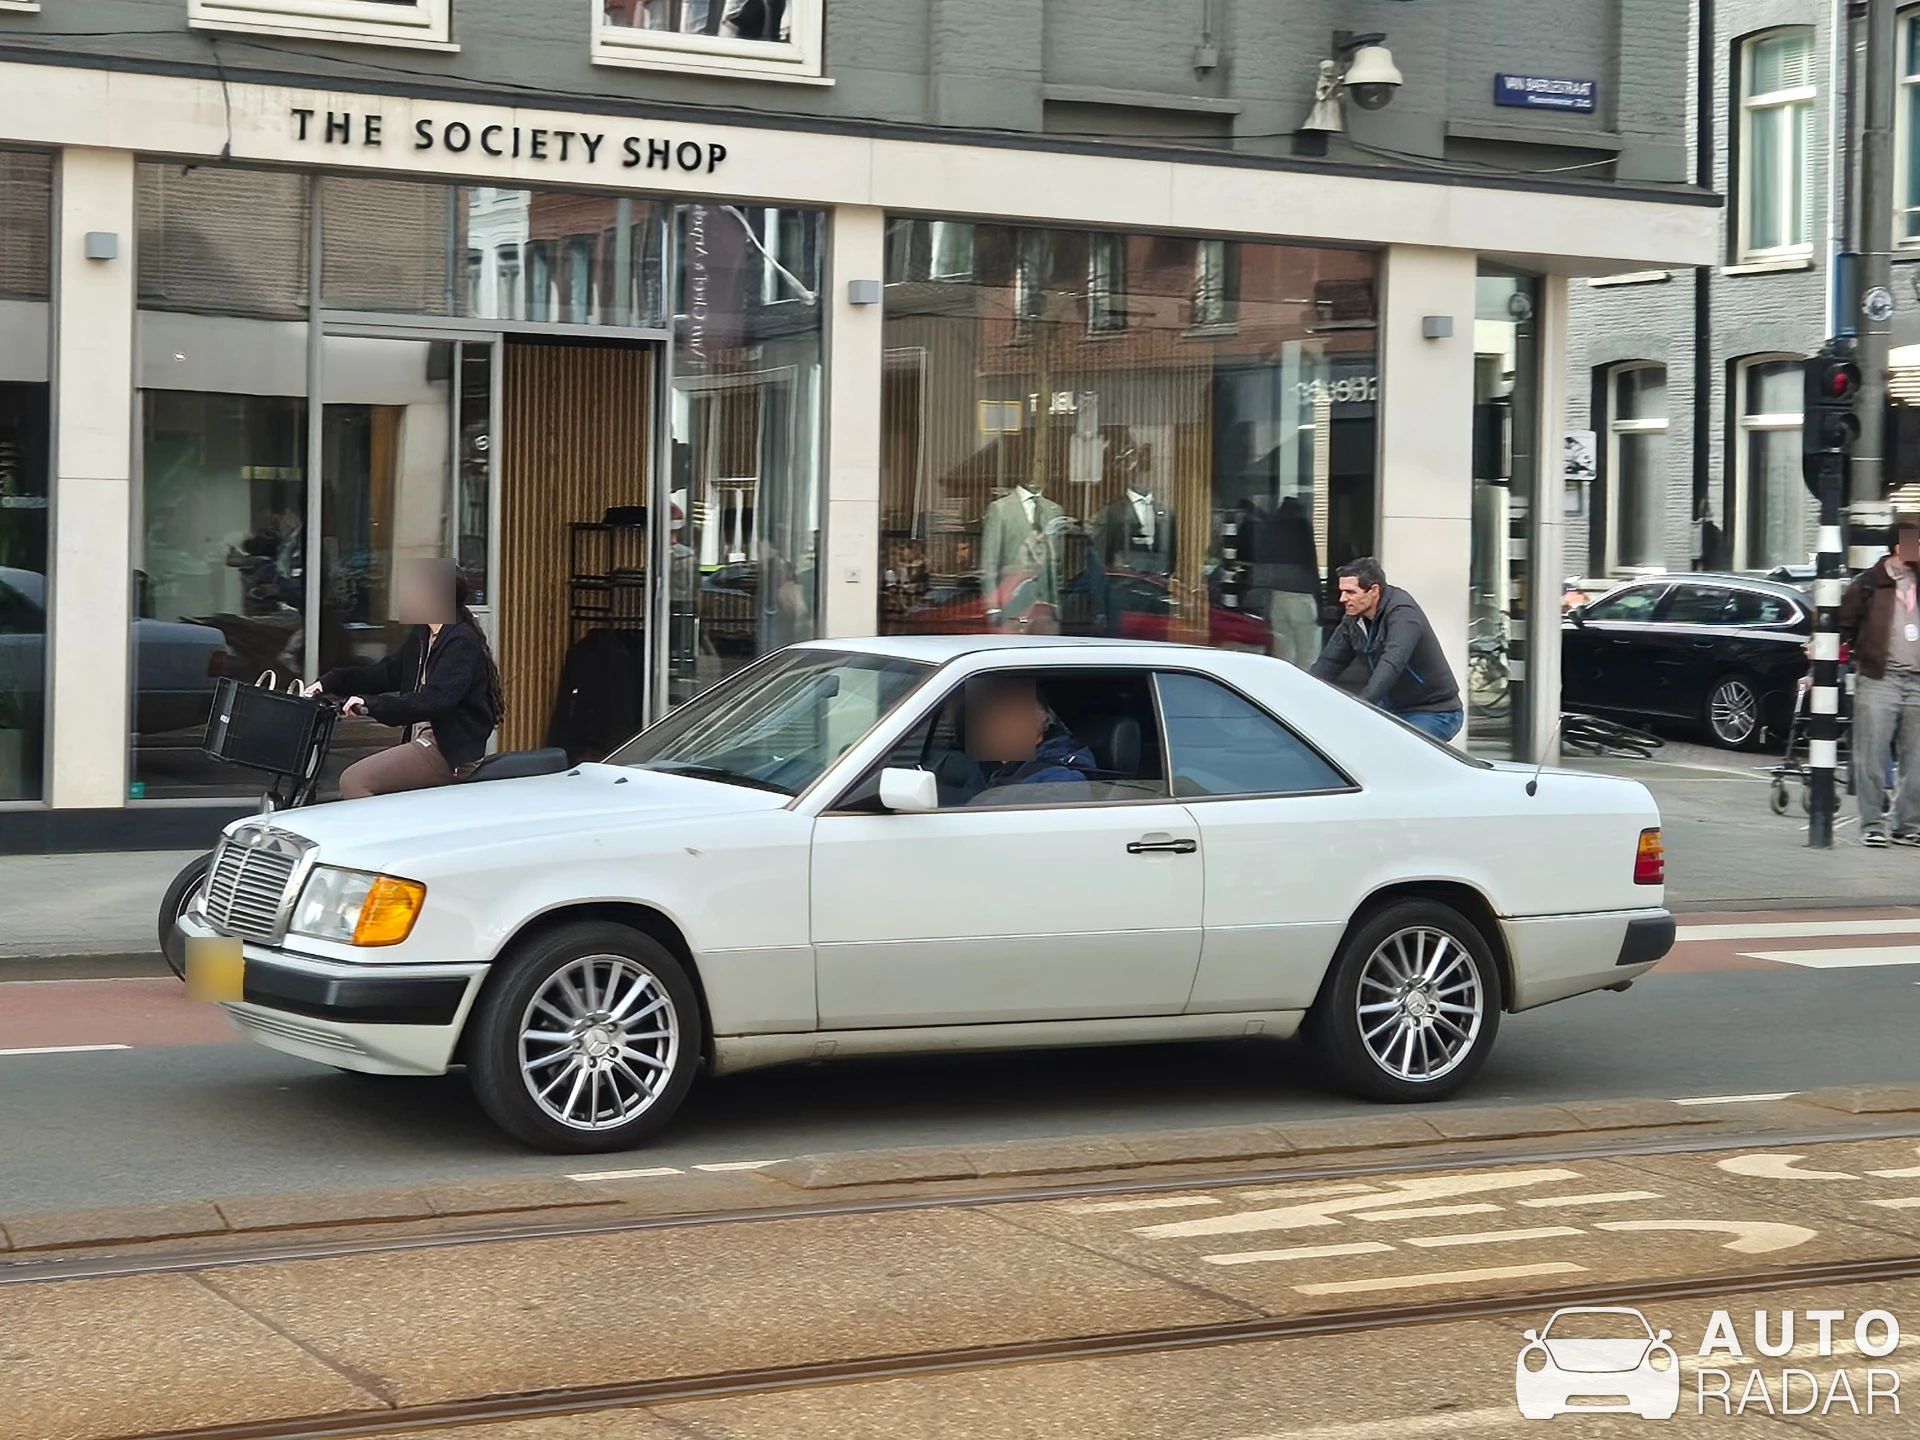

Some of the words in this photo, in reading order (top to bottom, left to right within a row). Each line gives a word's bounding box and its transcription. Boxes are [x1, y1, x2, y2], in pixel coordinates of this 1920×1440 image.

[291, 108, 383, 146] THE
[414, 119, 604, 163] SOCIETY
[622, 136, 728, 174] SHOP
